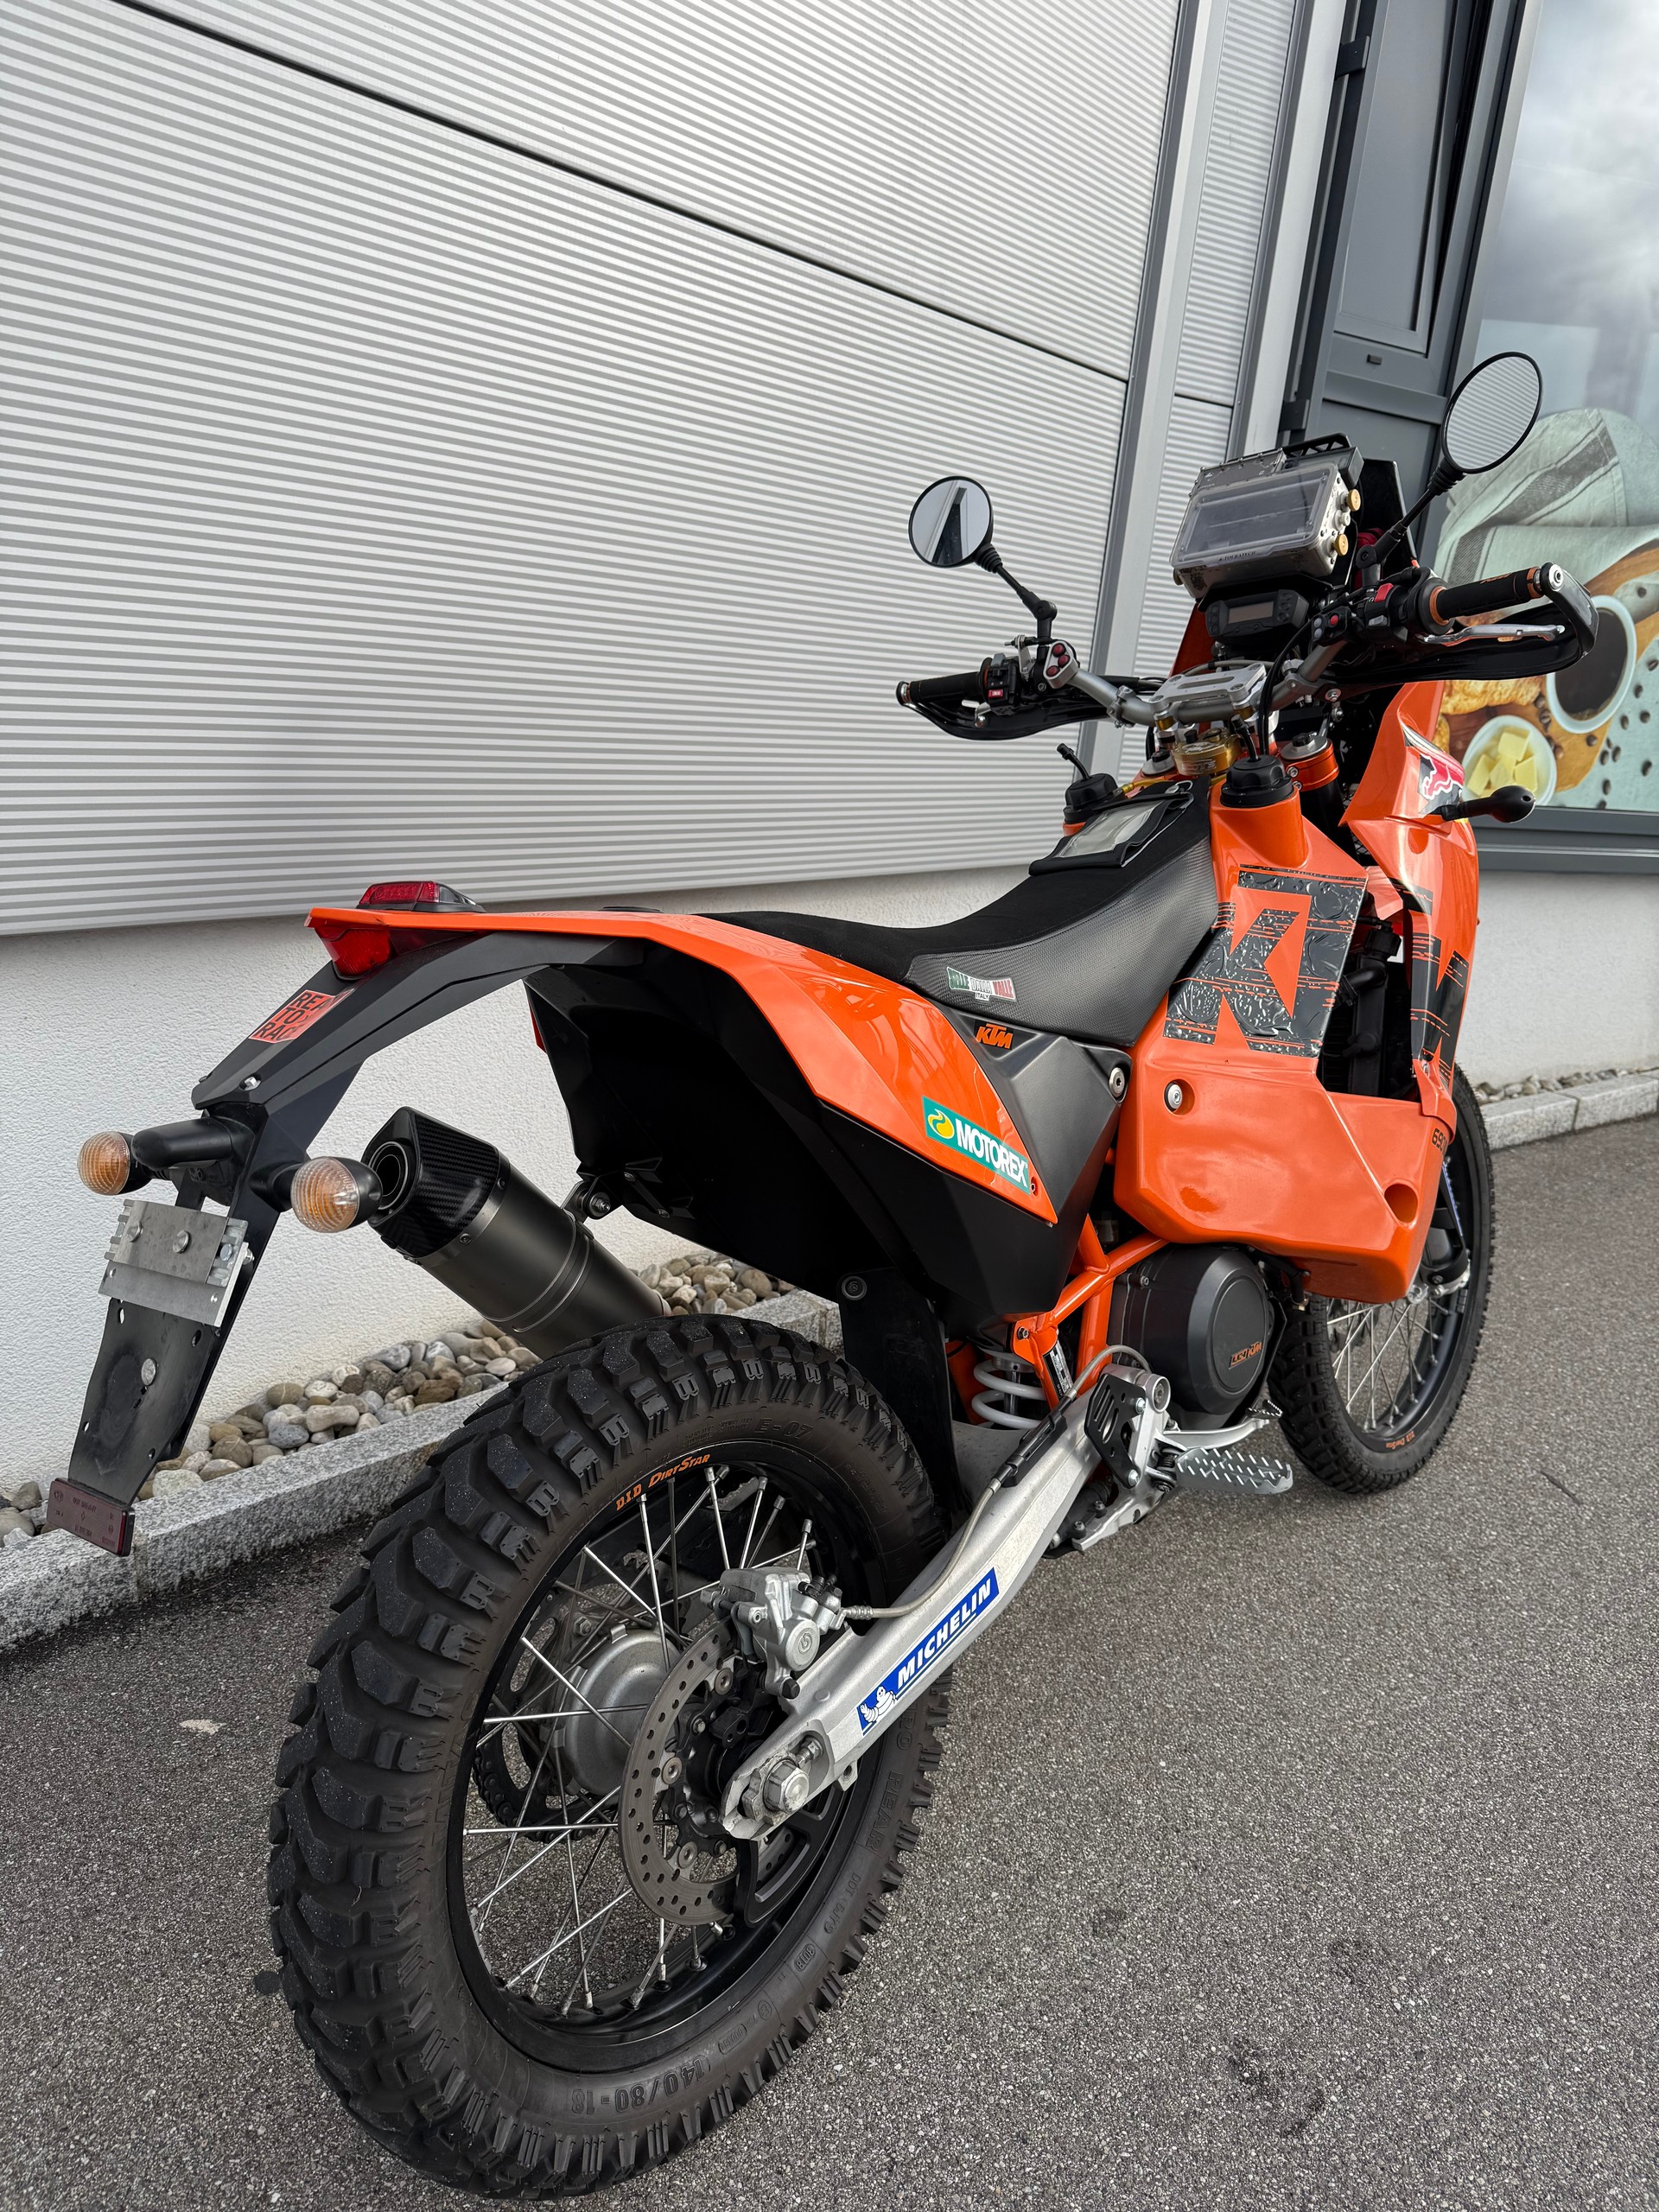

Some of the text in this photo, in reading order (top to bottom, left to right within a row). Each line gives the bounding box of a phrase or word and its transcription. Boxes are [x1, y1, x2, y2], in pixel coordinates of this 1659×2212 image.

[276, 1007, 306, 1025] TO
[976, 1023, 1013, 1049] KTM
[956, 1118, 1028, 1188] MOTOREX
[1247, 1341, 1262, 1357] KTM
[897, 1578, 991, 1690] MICHELIN
[866, 1769, 906, 1855] REAR
[848, 1872, 861, 1897] DOT
[795, 1945, 815, 1970] 3018
